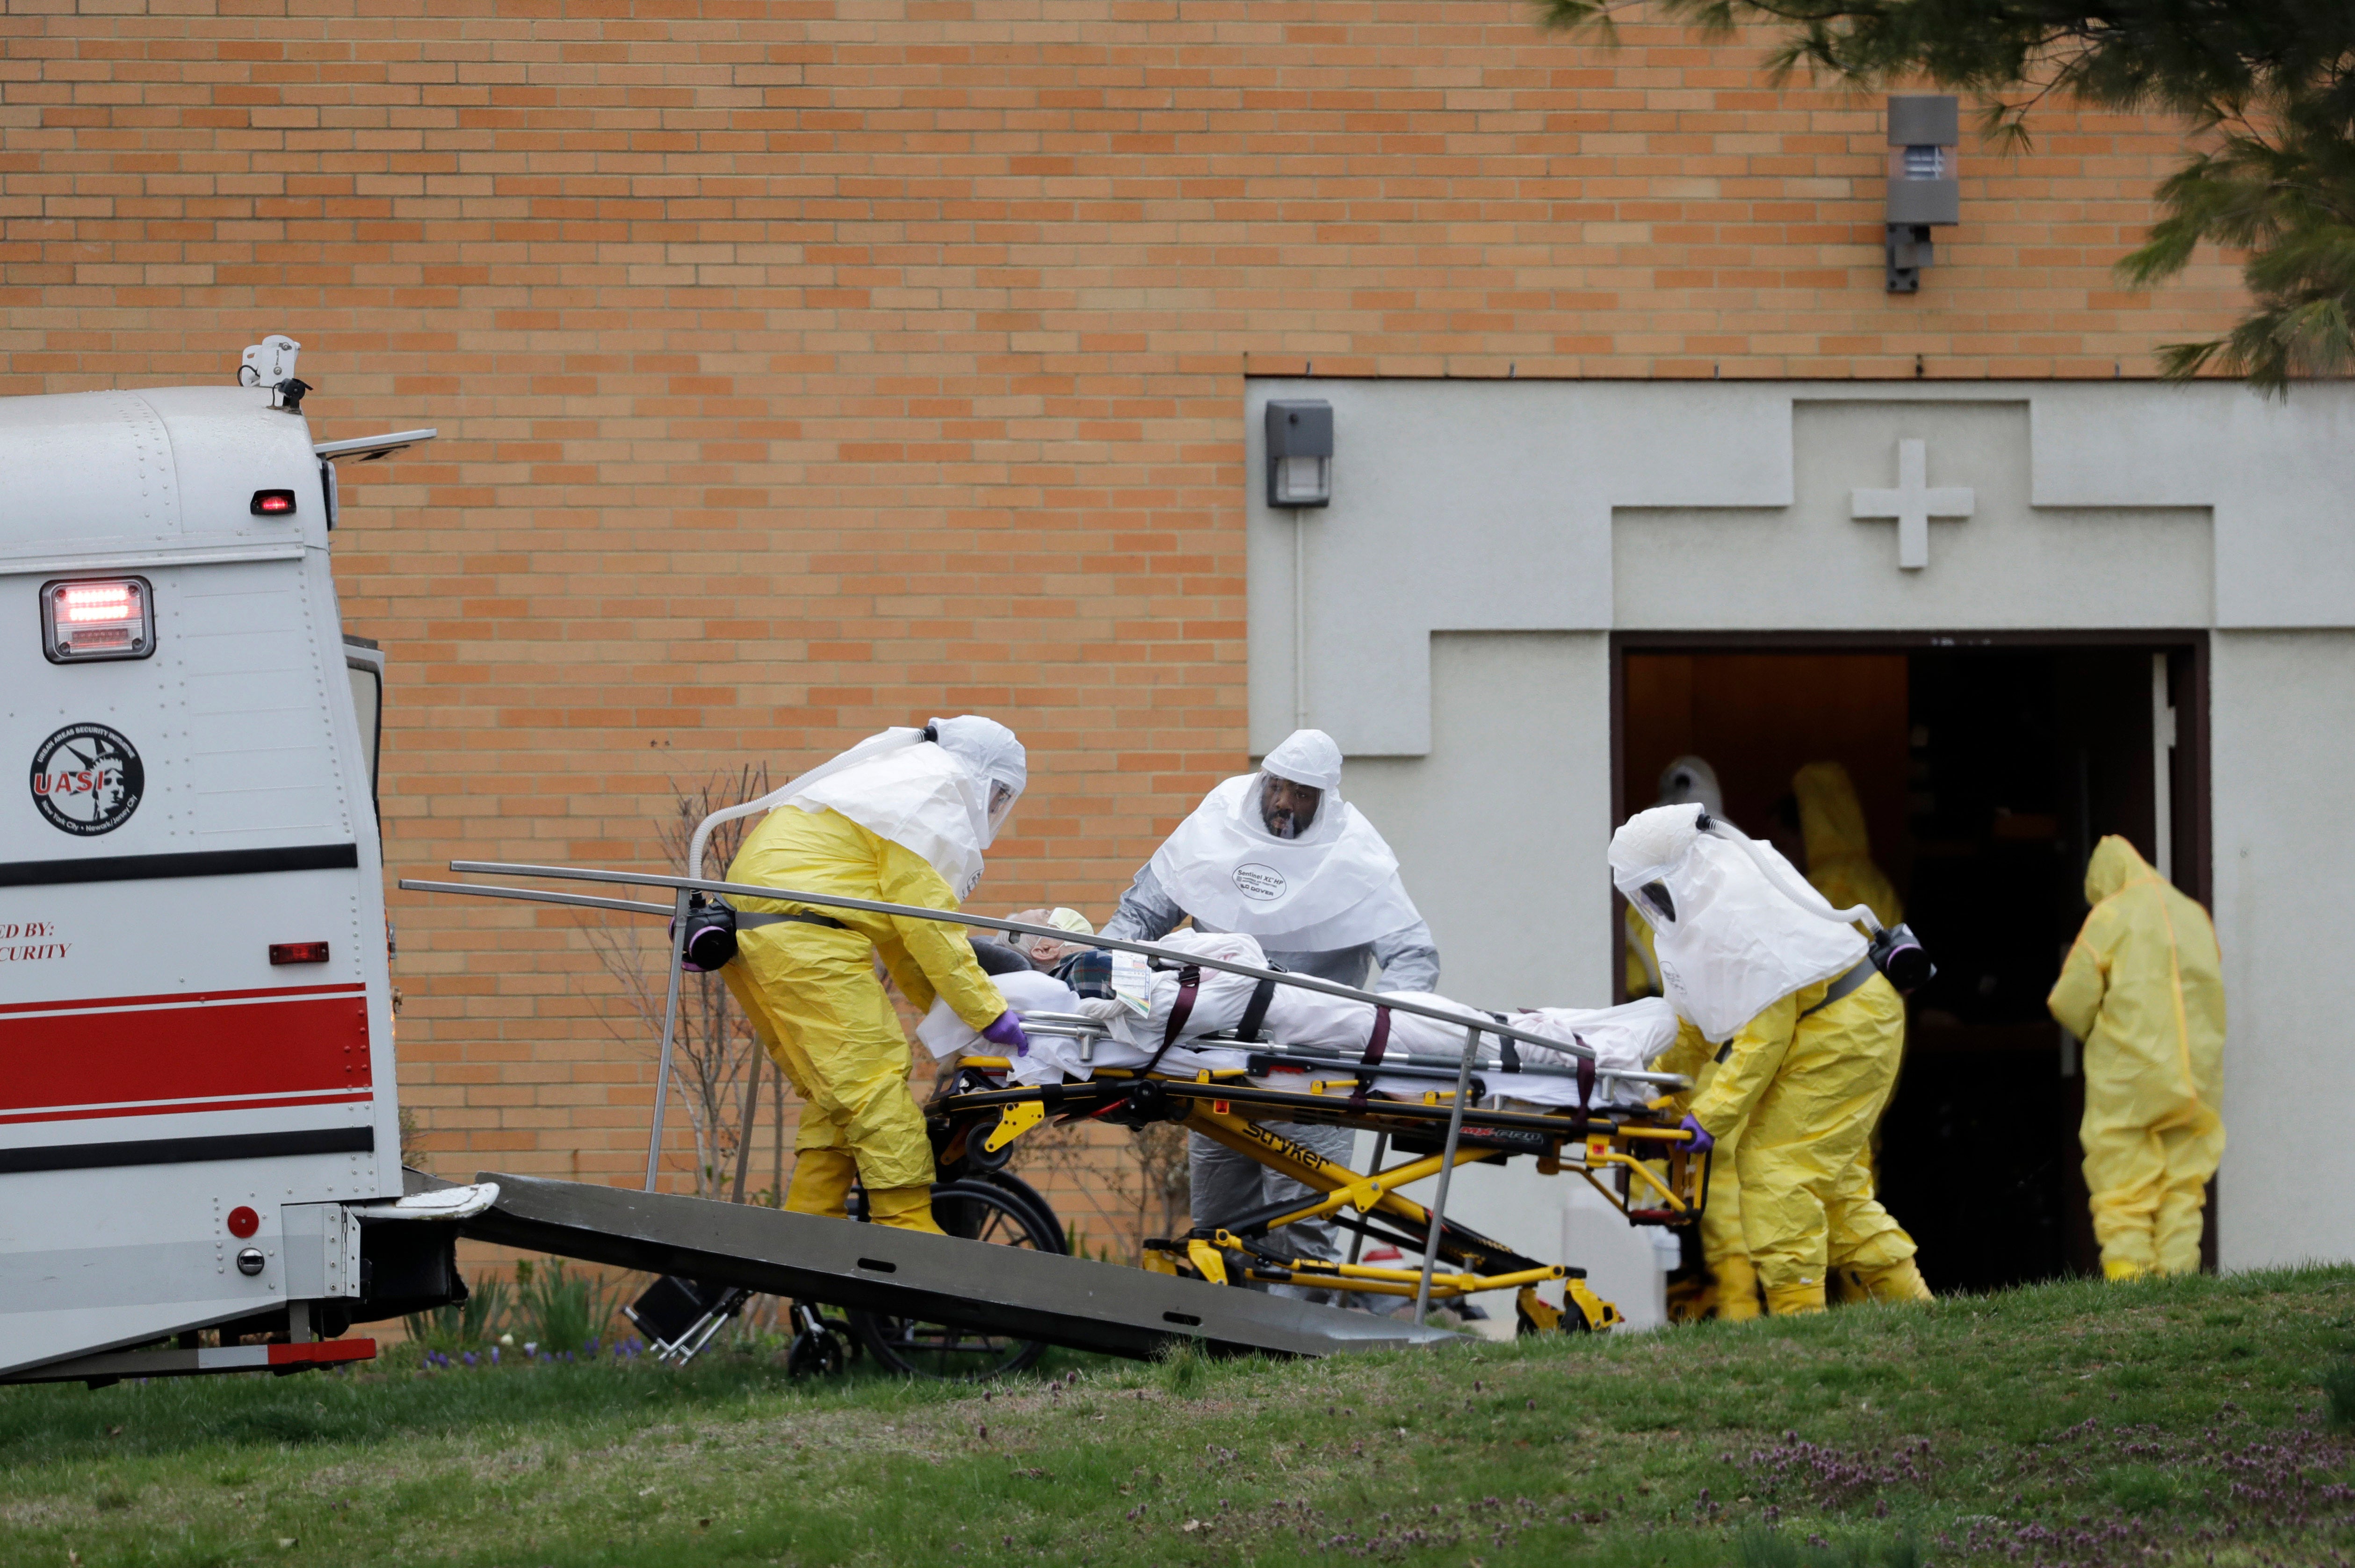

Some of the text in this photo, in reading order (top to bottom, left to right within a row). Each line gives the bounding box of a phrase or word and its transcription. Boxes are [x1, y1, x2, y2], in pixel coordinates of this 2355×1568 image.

[37, 740, 55, 762] URBAN
[53, 728, 75, 744] AREAS
[75, 726, 108, 737] SECURITY
[34, 771, 104, 794] UASI
[53, 812, 65, 827] York
[66, 821, 79, 831] City
[127, 794, 138, 808] City
[1237, 870, 1263, 880] Sentinel
[1250, 886, 1274, 897] DOVER
[24, 921, 55, 938] BY:
